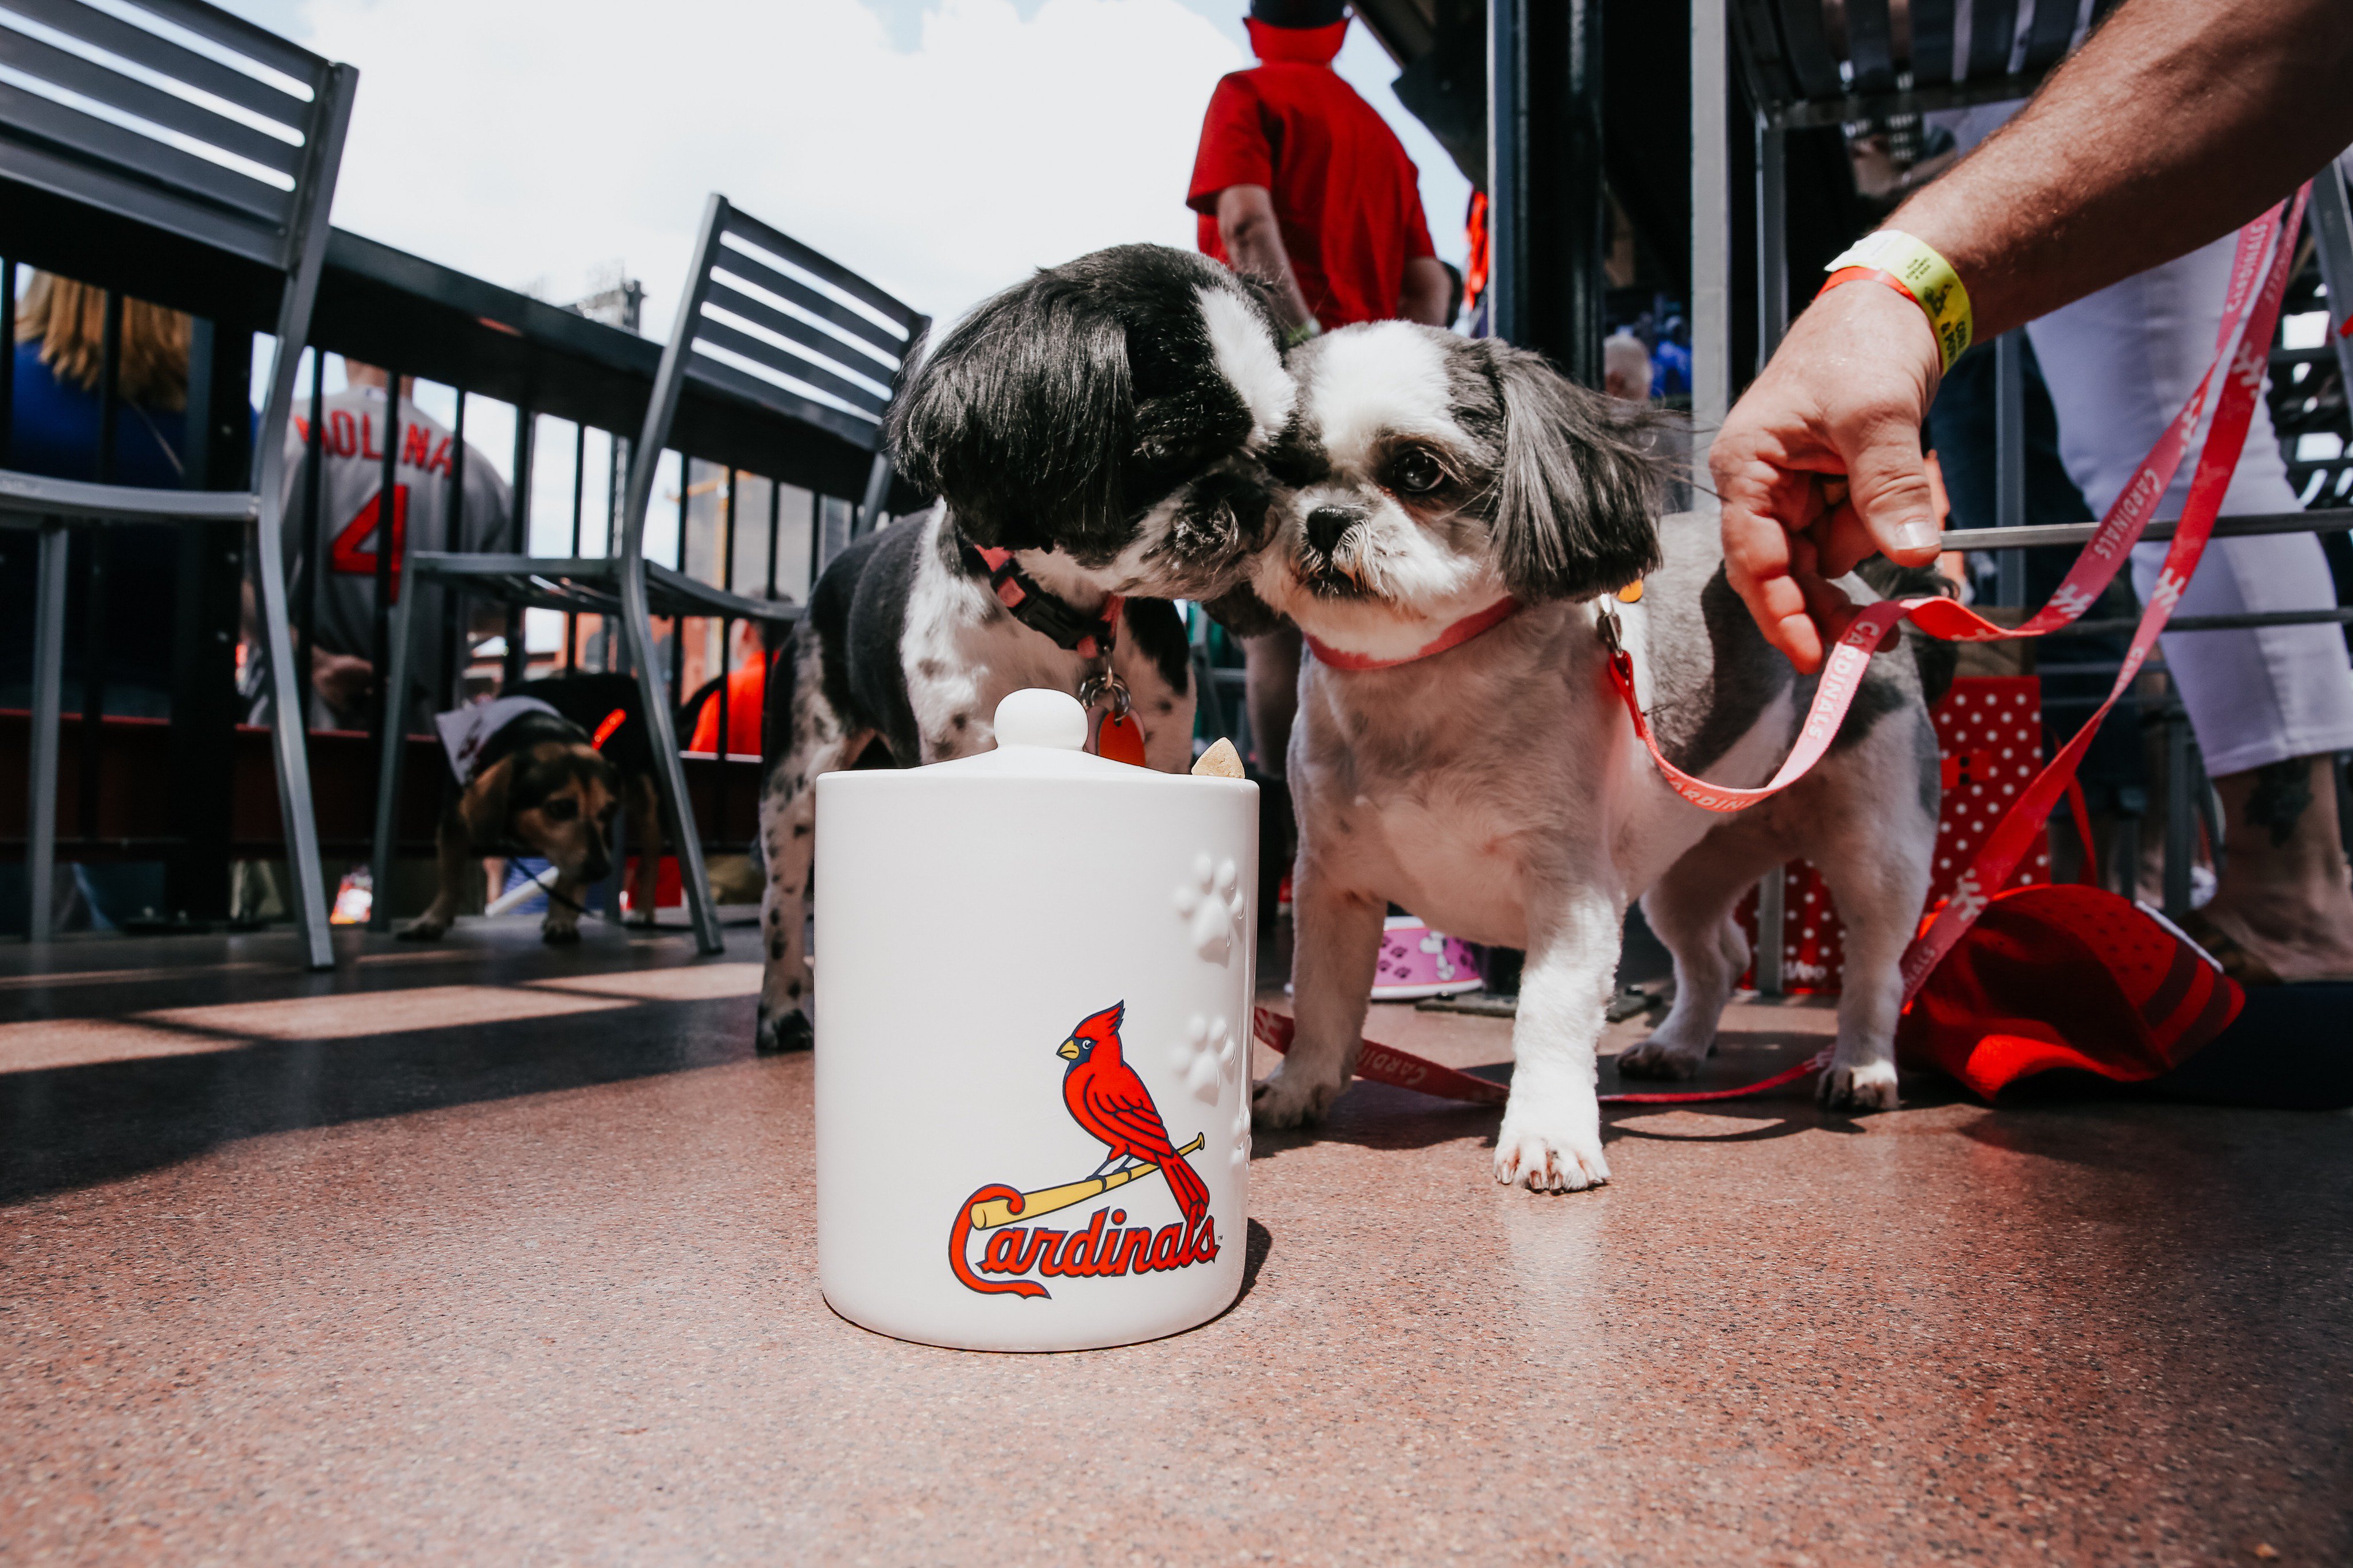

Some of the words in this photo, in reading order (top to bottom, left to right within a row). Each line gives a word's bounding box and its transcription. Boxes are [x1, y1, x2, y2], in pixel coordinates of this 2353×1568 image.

[332, 482, 408, 605] 4
[1808, 621, 1880, 740] CARDINALS
[948, 1183, 1221, 1299] Cardinals
